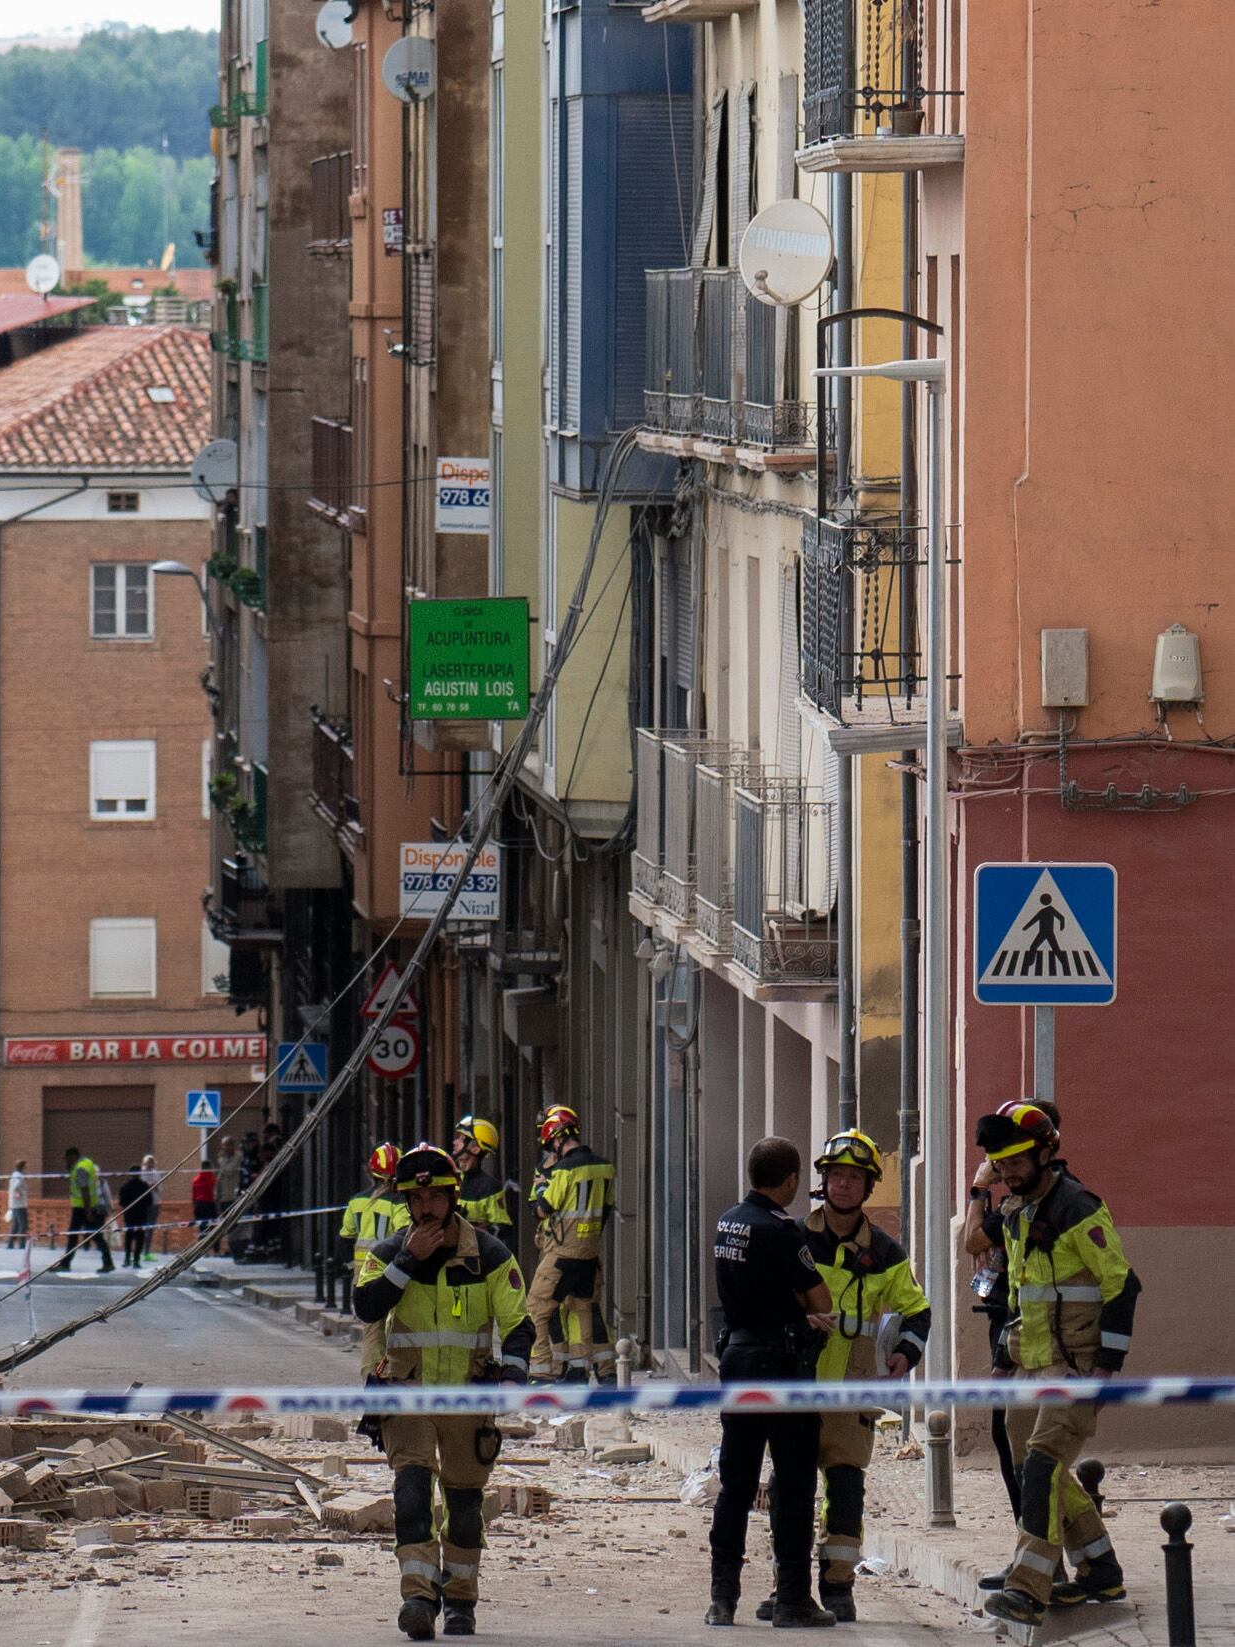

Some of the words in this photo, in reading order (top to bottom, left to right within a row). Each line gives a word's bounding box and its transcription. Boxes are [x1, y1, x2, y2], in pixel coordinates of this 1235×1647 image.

[441, 490, 469, 504] 978
[473, 491, 490, 506] 60
[426, 631, 511, 646] ACUPUNTURA
[423, 663, 514, 678] LASERTERAPIA
[424, 681, 478, 696] AGUSTIN
[485, 681, 515, 697] LOIS
[405, 848, 496, 870] Disponle
[405, 874, 433, 890] 978
[476, 876, 496, 891] 39
[69, 1041, 120, 1061] BAR
[130, 1040, 161, 1060] LA
[171, 1038, 266, 1058] COLME
[375, 1040, 409, 1059] 30
[726, 1235, 750, 1248] Local
[714, 1246, 746, 1262] ERUEL
